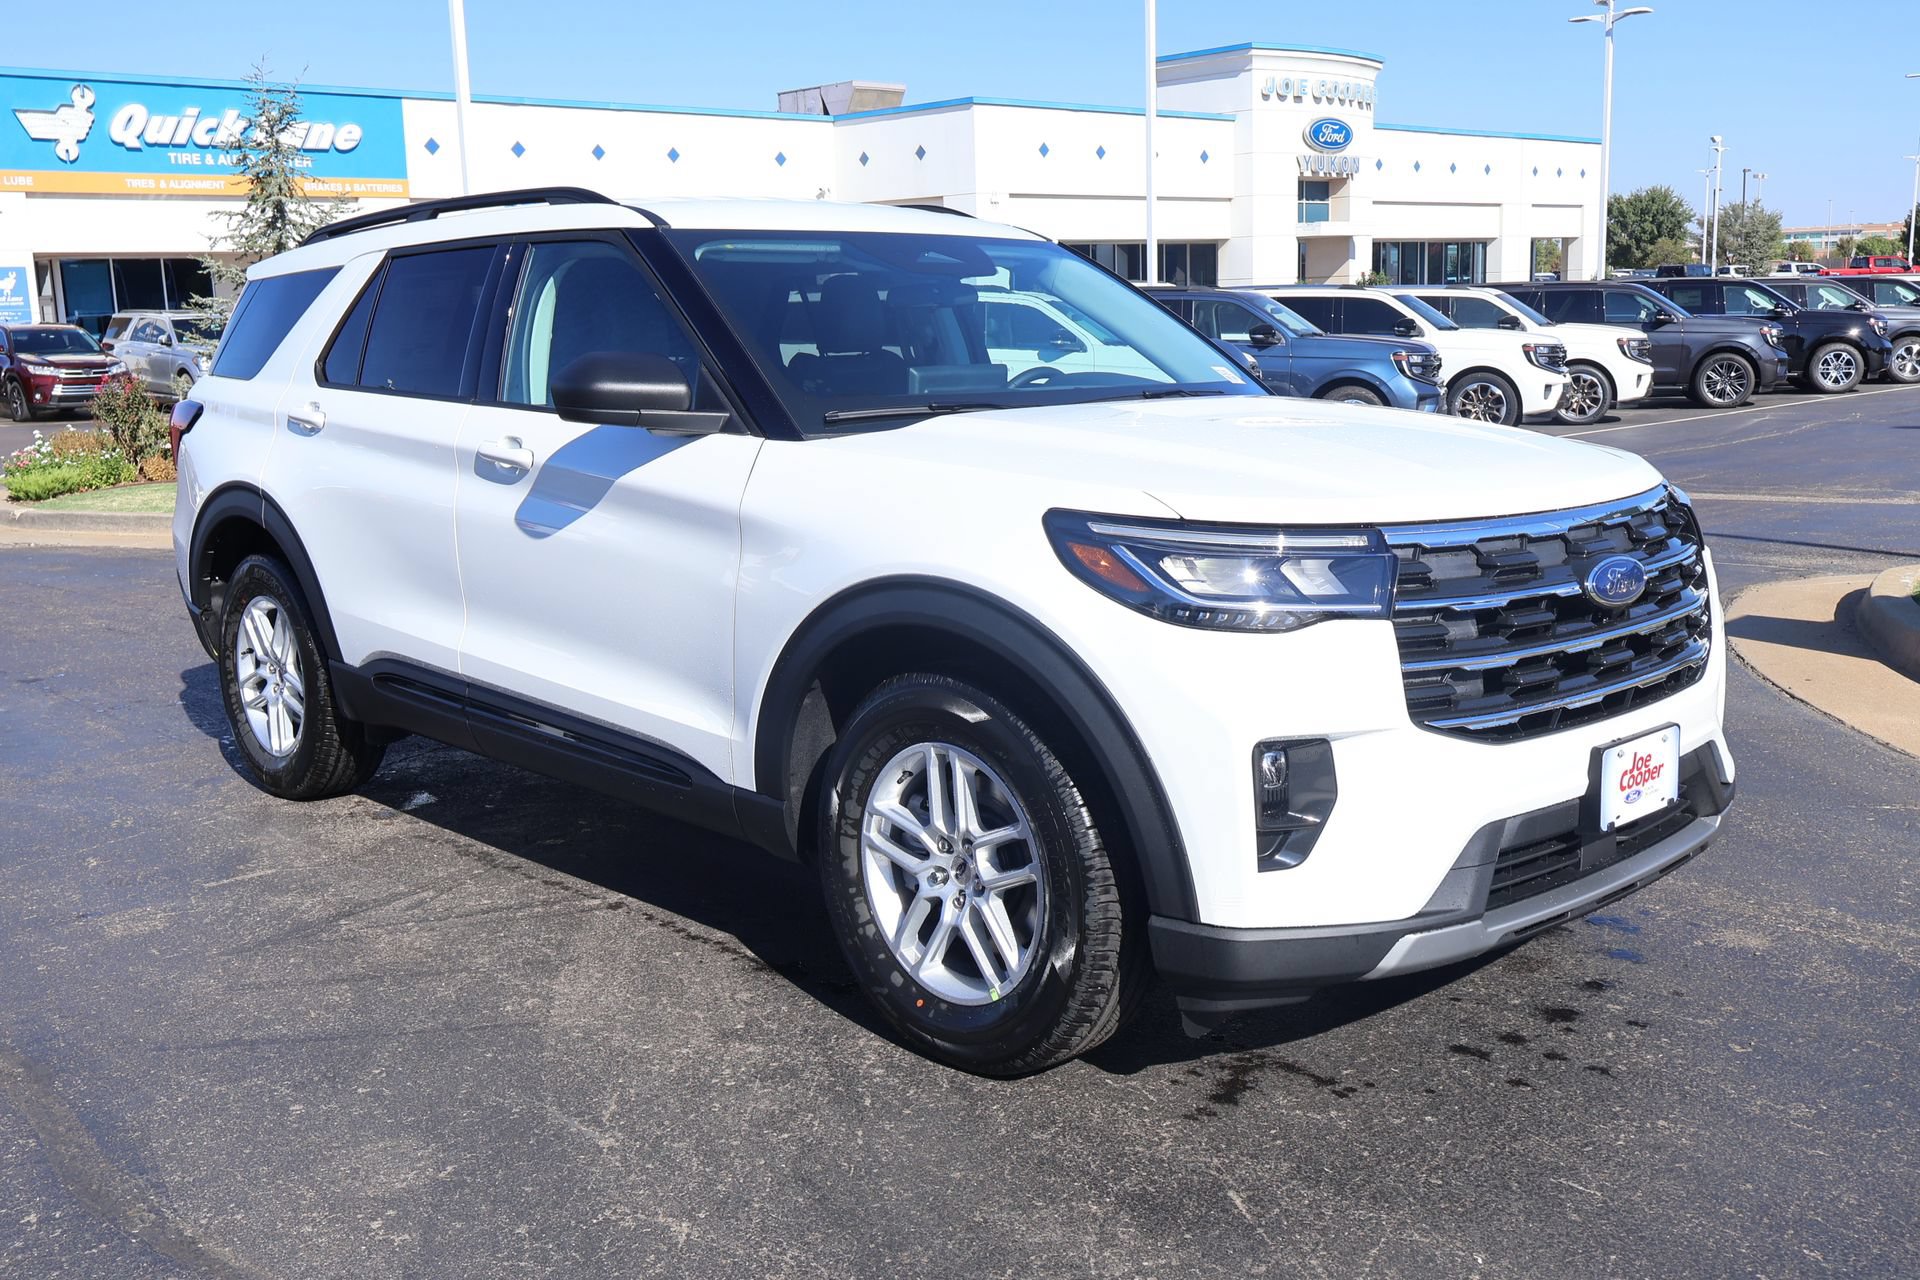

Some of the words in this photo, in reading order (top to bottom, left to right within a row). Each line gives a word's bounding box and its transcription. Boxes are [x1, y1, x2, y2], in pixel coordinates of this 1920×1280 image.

[1262, 76, 1308, 97] JOE
[1312, 80, 1377, 104] COOPER
[109, 103, 251, 151] Quick
[1319, 123, 1346, 143] Ford
[167, 152, 202, 165] TIRE
[205, 154, 215, 165] &
[217, 154, 256, 167] AUO
[1302, 155, 1360, 174] YUKON
[3, 176, 33, 186] LUBE
[125, 178, 155, 188] TIRES
[159, 180, 167, 188] &
[169, 180, 225, 189] ALIGNMENT
[304, 182, 343, 191] BRAKES
[353, 183, 403, 193] BATTERIES
[1607, 566, 1637, 595] Ford
[1629, 752, 1652, 774] Joe
[1620, 763, 1665, 792] Cooper
